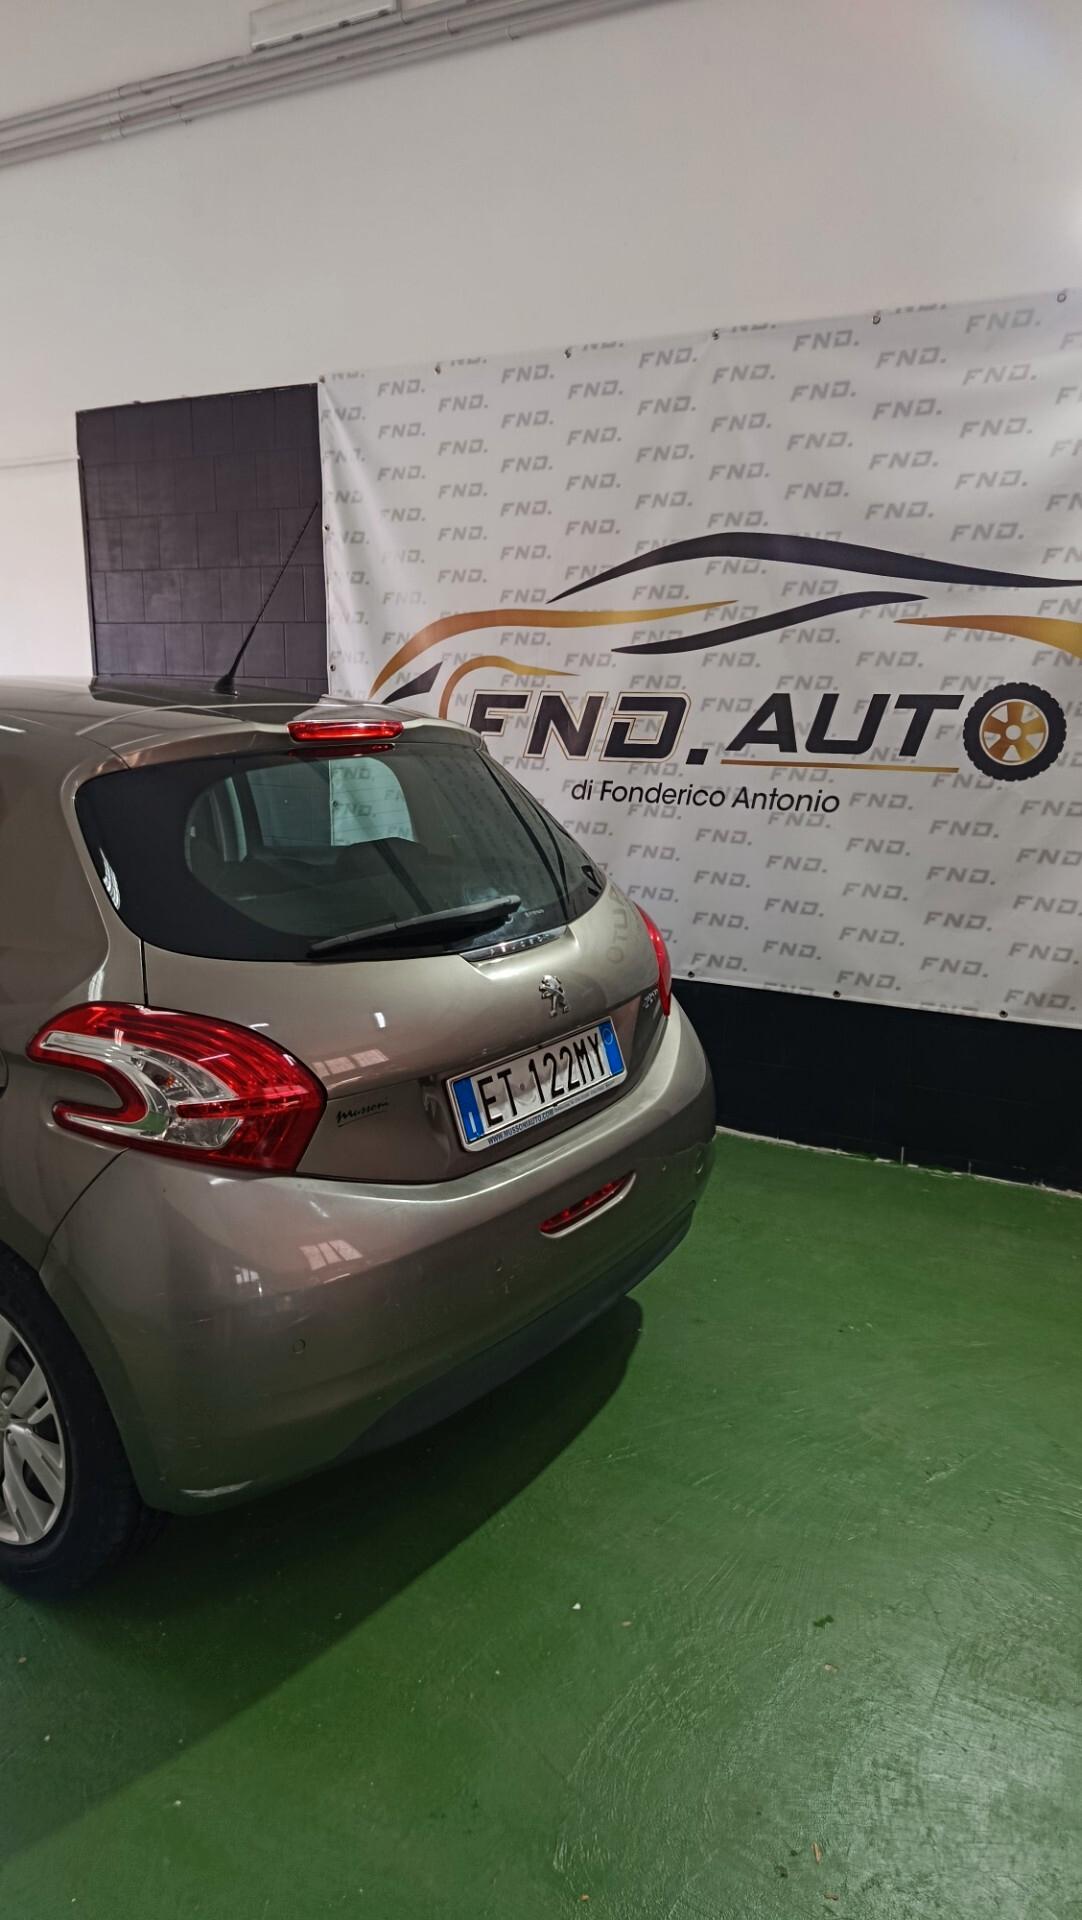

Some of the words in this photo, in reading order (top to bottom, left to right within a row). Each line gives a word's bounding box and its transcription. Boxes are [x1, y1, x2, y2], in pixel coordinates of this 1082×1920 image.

[965, 307, 1041, 335] FND.
[792, 328, 860, 353] FND.
[637, 346, 698, 369] FND.
[875, 345, 947, 369] FND.
[500, 363, 555, 385] FND.
[711, 363, 776, 385] FND.
[962, 364, 1037, 386] FND.
[377, 378, 426, 397] FND.
[567, 379, 625, 401] FND.
[789, 379, 857, 403] FND.
[437, 393, 489, 413] FND.
[636, 394, 697, 417] FND.
[871, 397, 943, 421] FND.
[500, 409, 554, 430] FND.
[709, 411, 772, 433] FND.
[959, 417, 1033, 439] FND.
[377, 421, 426, 440] FND.
[566, 426, 622, 447] FND.
[437, 437, 489, 457] FND.
[786, 431, 854, 452] FND.
[635, 443, 695, 464] FND.
[868, 449, 939, 471] FND.
[375, 464, 426, 483] FND.
[500, 455, 553, 474] FND.
[708, 461, 771, 481] FND.
[564, 472, 622, 492] FND.
[953, 469, 1028, 490] FND.
[437, 481, 489, 500] FND.
[634, 490, 694, 511] FND.
[783, 480, 849, 501] FND.
[499, 499, 553, 518] FND.
[864, 500, 935, 521] FND.
[564, 518, 621, 537] FND.
[708, 510, 769, 529] FND.
[437, 525, 488, 542] FND.
[950, 521, 1025, 542] FND.
[499, 544, 552, 561] FND.
[436, 568, 488, 584] FND.
[632, 584, 690, 601] FND.
[500, 632, 551, 647] FND.
[778, 628, 841, 644] FND.
[564, 652, 617, 668] FND.
[702, 652, 761, 668] FND.
[855, 650, 924, 668] FND.
[629, 675, 687, 690] FND.
[775, 675, 839, 691] FND.
[467, 688, 709, 765] FND.
[571, 779, 594, 801] di
[600, 779, 726, 807] Fonderico
[731, 786, 840, 813] Antonio
[849, 792, 914, 811] FND.
[694, 827, 753, 847] FND.
[928, 819, 1000, 839] FND.
[626, 843, 681, 862] FND.
[845, 836, 911, 857] FND.
[765, 854, 828, 874] FND.
[692, 869, 751, 889] FND.
[925, 865, 997, 886] FND.
[627, 884, 680, 903] FND.
[841, 882, 909, 902] FND.
[763, 897, 825, 918] FND.
[691, 911, 750, 931] FND.
[922, 910, 993, 933] FND.
[837, 926, 905, 947] FND.
[762, 939, 823, 961] FND.
[1007, 941, 1082, 966] FND.
[691, 951, 748, 972] FND.
[919, 956, 989, 979] FND.
[836, 969, 901, 991] FND.
[1003, 988, 1076, 1011] FND.
[477, 1067, 518, 1128] ET
[528, 1032, 605, 1105] 122MY
